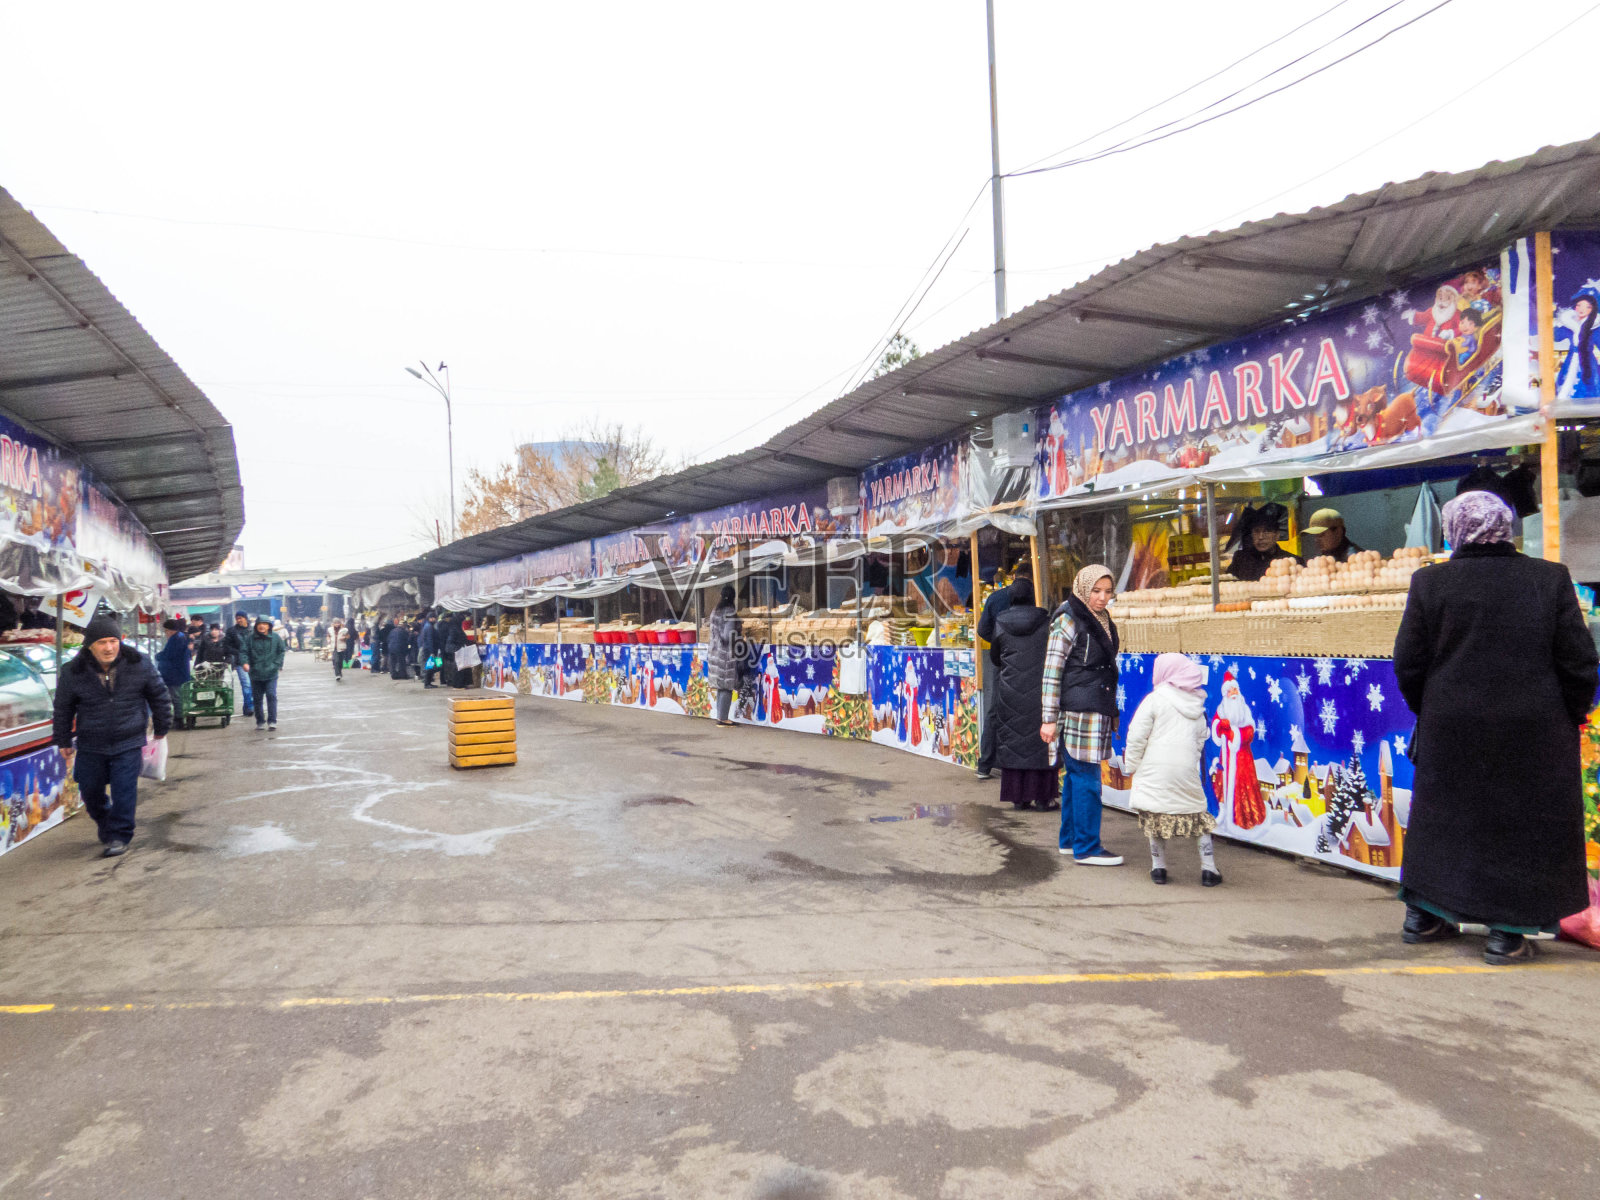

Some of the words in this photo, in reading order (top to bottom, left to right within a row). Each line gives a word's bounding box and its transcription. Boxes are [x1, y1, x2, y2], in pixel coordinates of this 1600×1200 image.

[1090, 338, 1350, 452] YARMARKA
[0, 433, 42, 498] RKA
[870, 458, 940, 507] YARMARKA
[711, 502, 811, 547] YARMARKA
